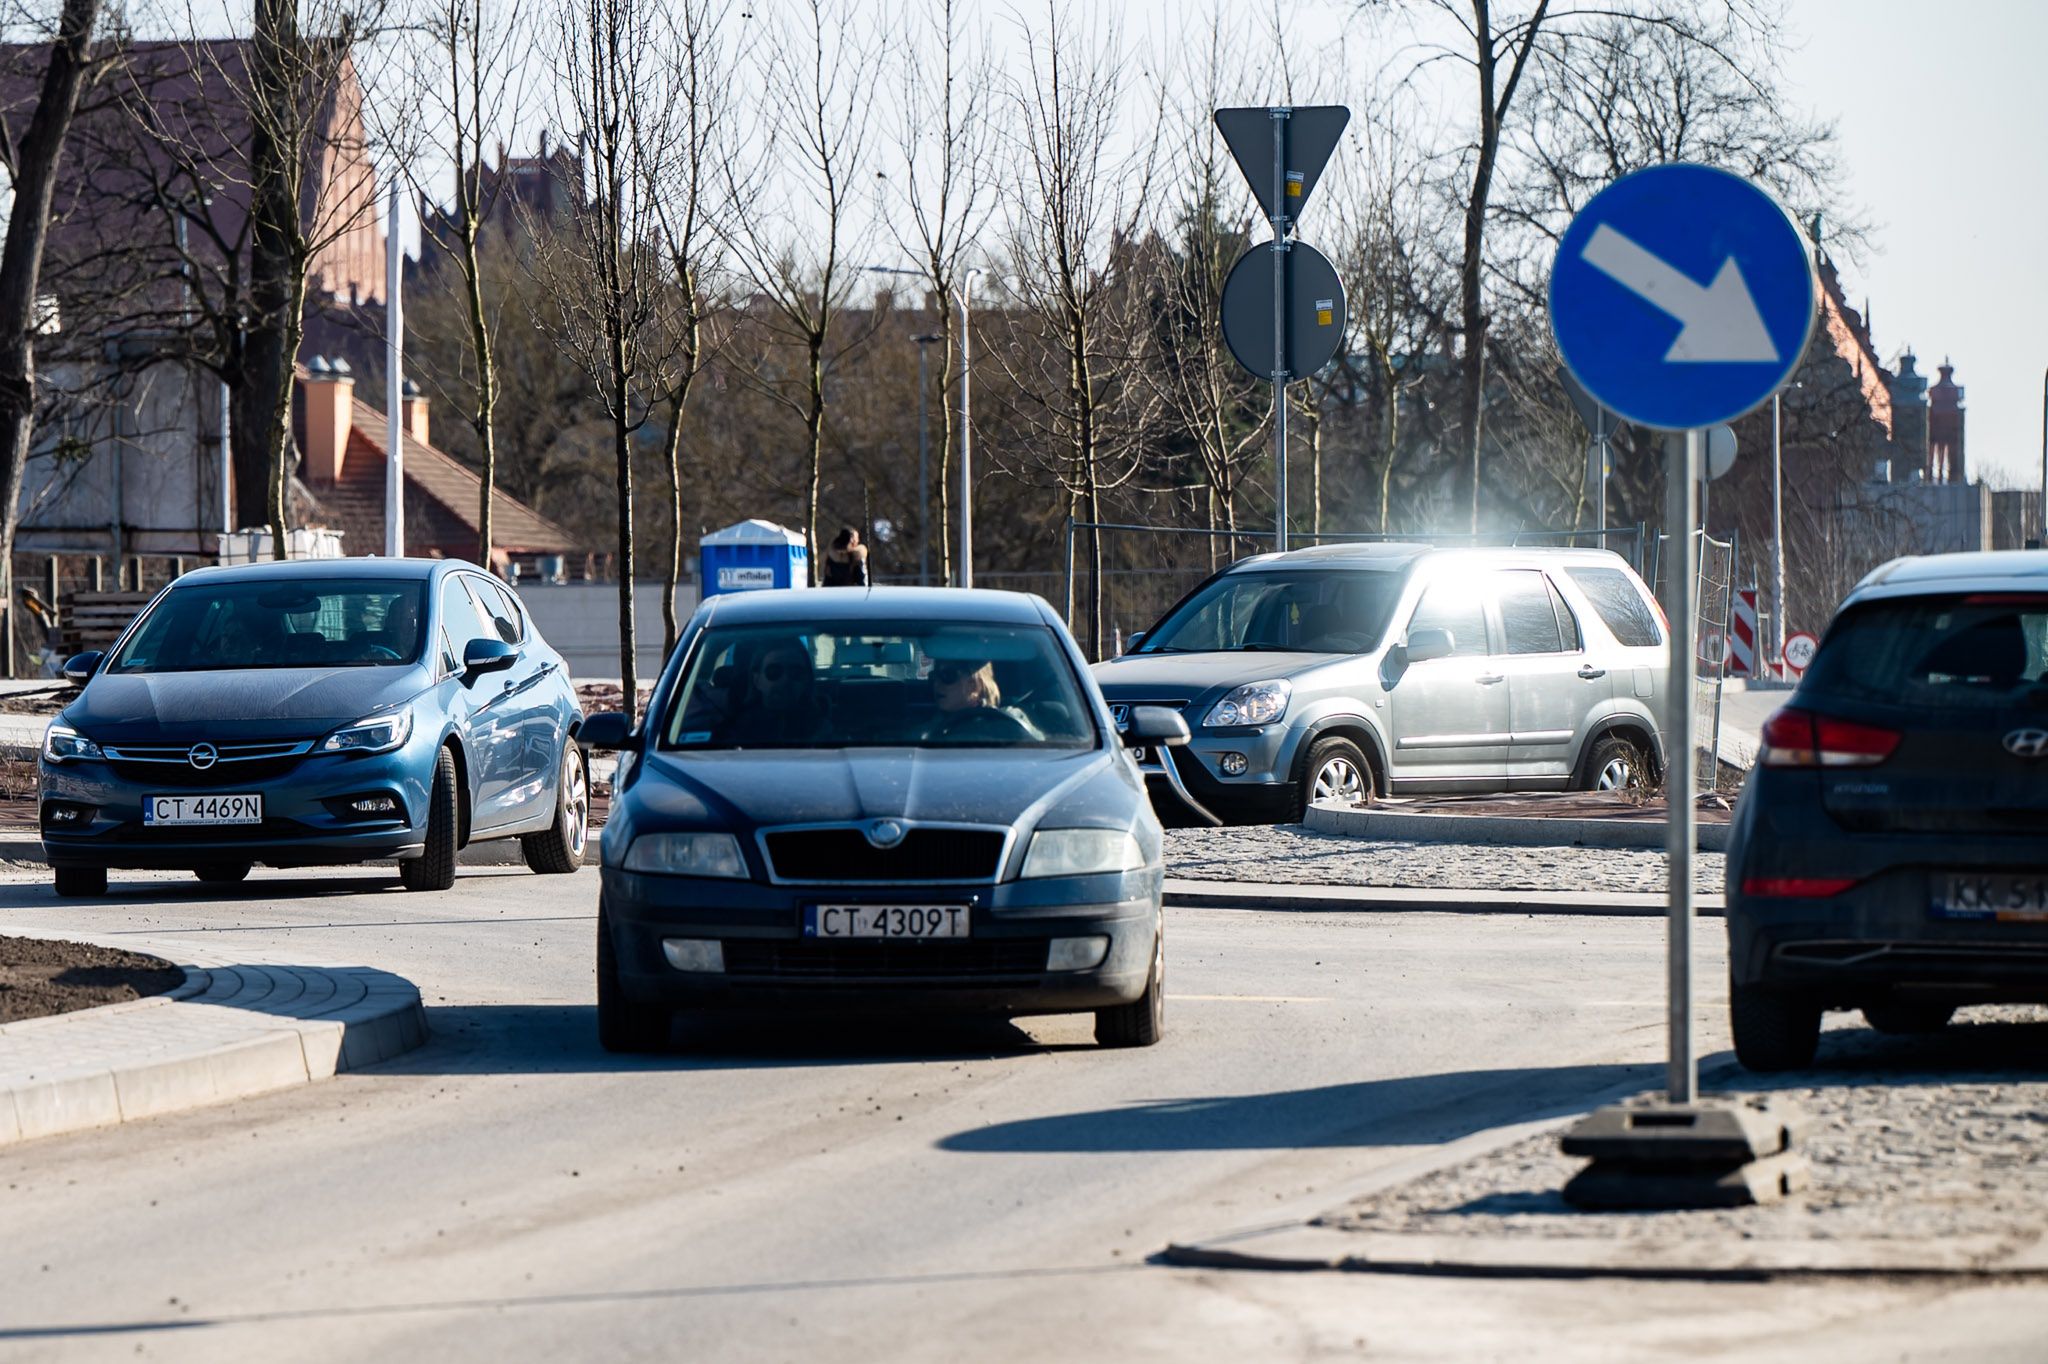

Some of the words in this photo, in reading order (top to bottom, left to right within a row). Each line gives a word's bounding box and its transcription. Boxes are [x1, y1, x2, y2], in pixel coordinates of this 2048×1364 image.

[156, 799, 185, 819] CT
[193, 798, 258, 818] 4469N
[1953, 878, 1993, 910] KK
[823, 908, 860, 935] CT
[872, 908, 961, 935] 4309T
